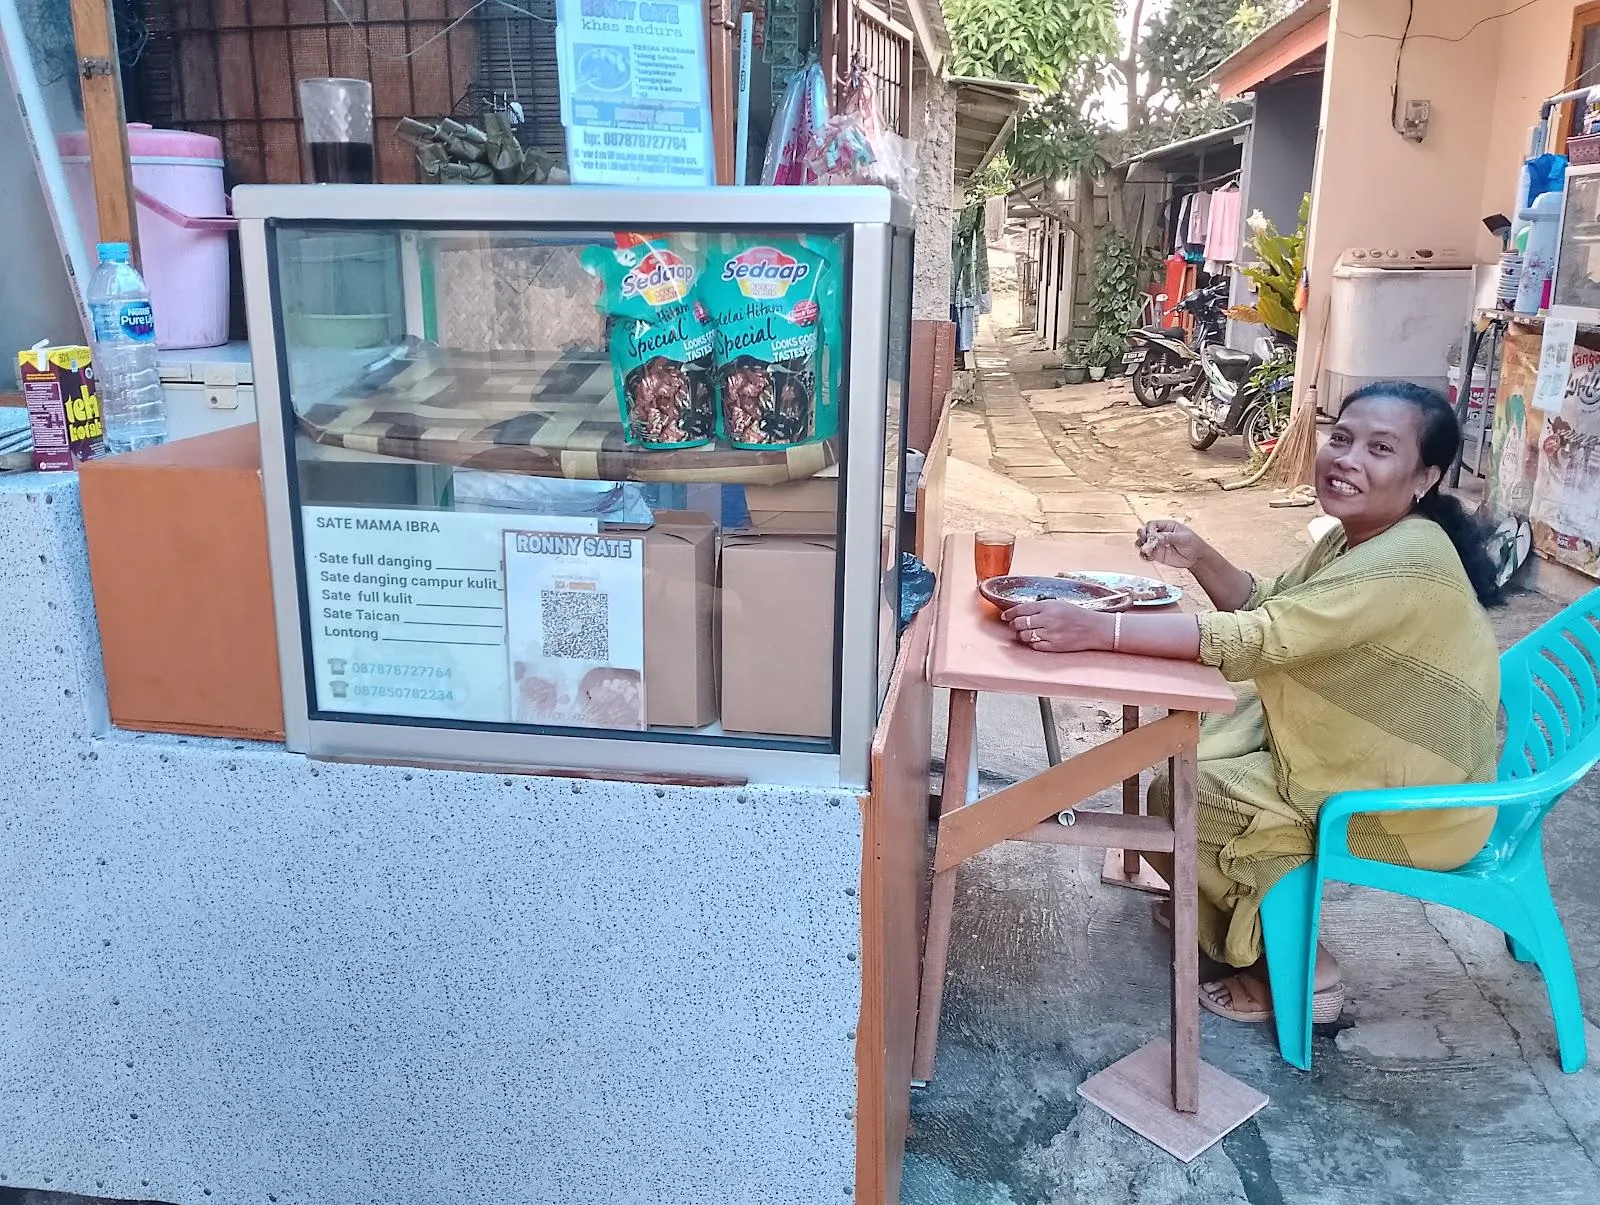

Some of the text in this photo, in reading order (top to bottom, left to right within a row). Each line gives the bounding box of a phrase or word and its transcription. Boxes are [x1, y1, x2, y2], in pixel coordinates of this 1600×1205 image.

[582, 18, 683, 38] khas madura
[722, 259, 809, 284] Sedaap
[120, 315, 145, 326] Pure
[713, 307, 744, 327] delai
[628, 317, 689, 361] Special
[716, 317, 777, 359] Special
[770, 336, 799, 351] LOOKS
[772, 347, 806, 362] TASTES
[64, 384, 100, 423] teh
[316, 517, 440, 533] SATE MAMA IBRA
[516, 534, 632, 559] RONNY SATE
[319, 552, 432, 570] Sate full danging
[320, 571, 497, 590] Sate danging campur kulit
[322, 589, 413, 604] Sate full kulit
[323, 608, 400, 622] Sate Taican
[324, 626, 379, 641] Lontong
